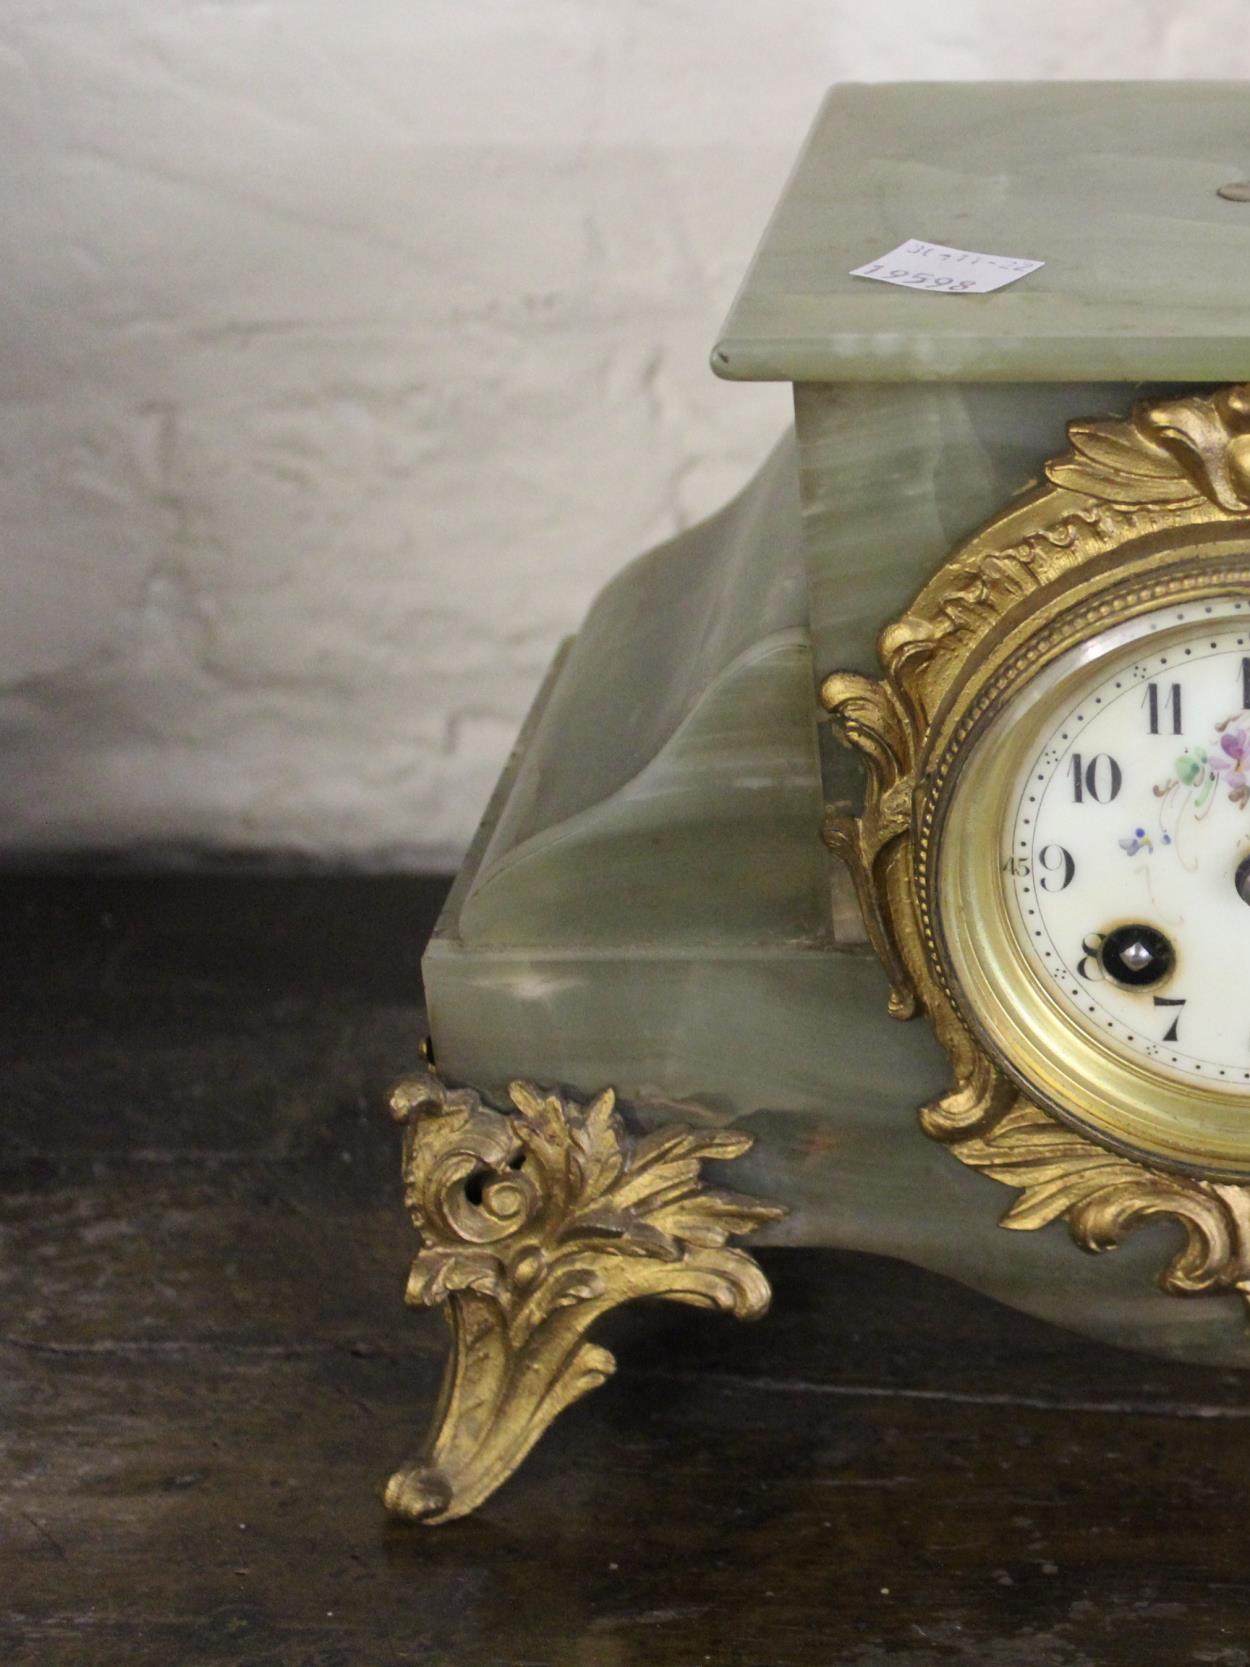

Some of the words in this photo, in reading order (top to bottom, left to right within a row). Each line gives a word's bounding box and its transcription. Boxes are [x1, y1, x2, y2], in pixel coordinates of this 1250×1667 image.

[863, 264, 976, 291] 19598
[1145, 682, 1181, 736] 11
[1070, 752, 1122, 804] 10
[1002, 855, 1030, 877] 45
[1038, 843, 1076, 892] 9
[1154, 997, 1186, 1042] 7
